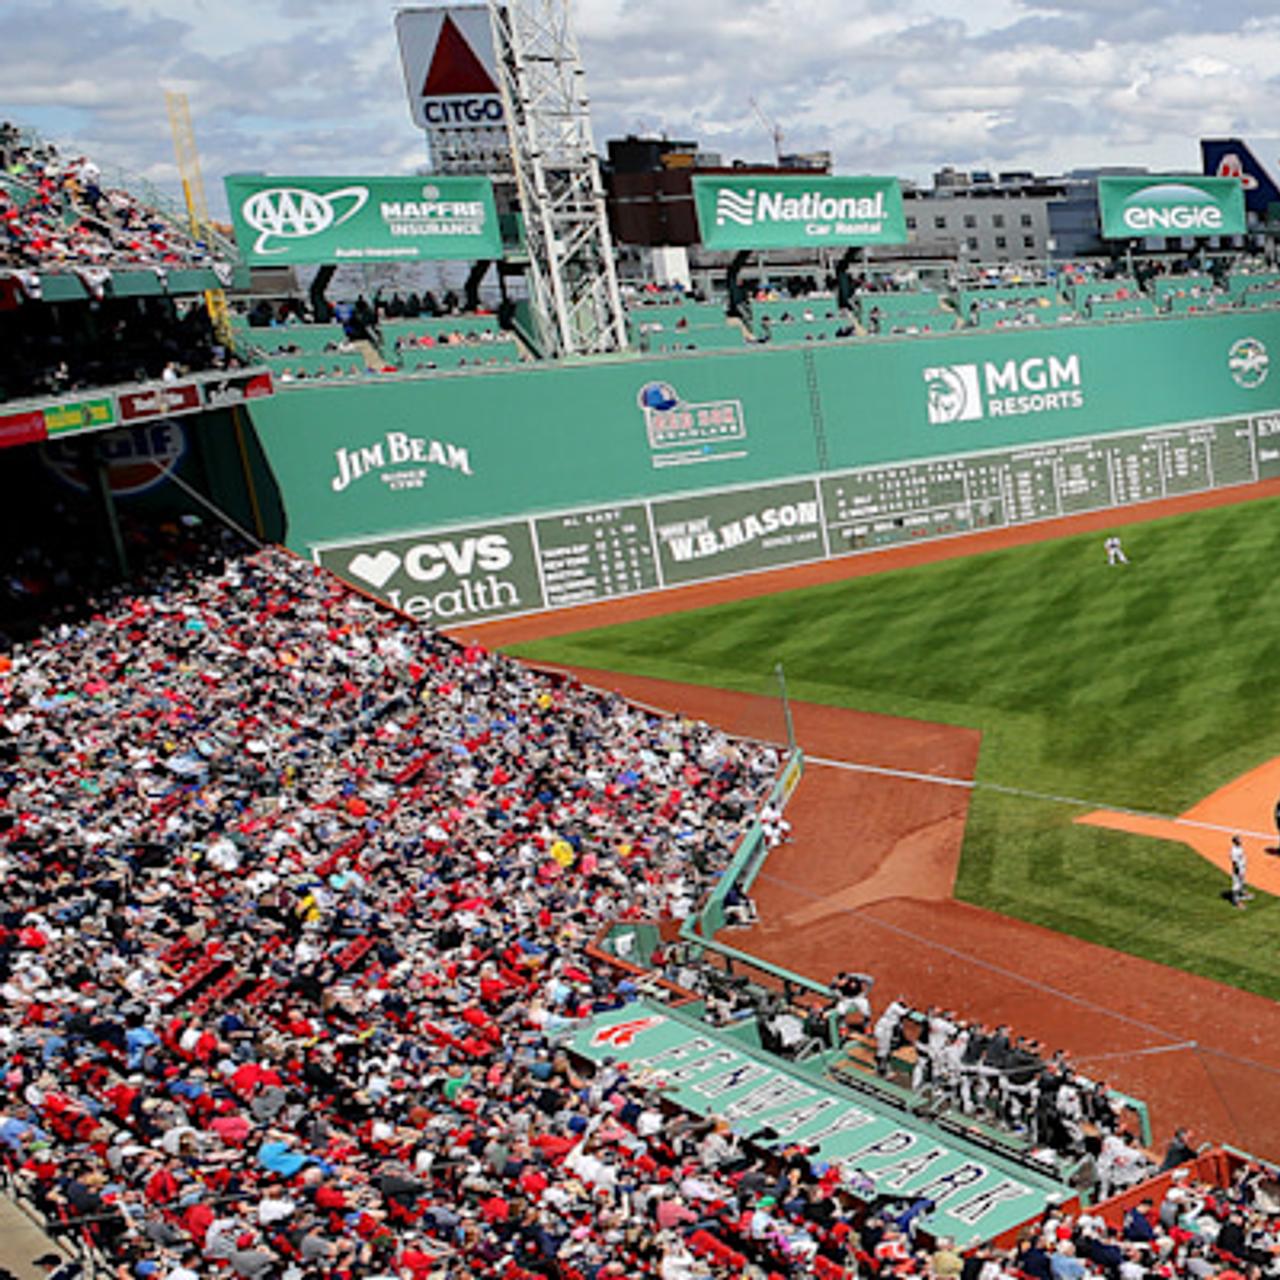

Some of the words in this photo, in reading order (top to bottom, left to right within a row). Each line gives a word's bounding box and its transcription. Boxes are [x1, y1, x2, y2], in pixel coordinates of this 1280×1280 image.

[424, 99, 503, 123] CITGO
[255, 190, 323, 234] AAA
[380, 202, 484, 219] MAPFRE
[806, 223, 830, 236] Car
[835, 222, 882, 235] Rental
[984, 354, 1080, 394] MGM
[989, 389, 1084, 416] RESORTS
[332, 443, 385, 491] JIM
[386, 432, 474, 475] BEAM
[404, 534, 513, 581] CVS
[386, 575, 521, 620] ealth
[840, 1127, 1033, 1224] PARK
